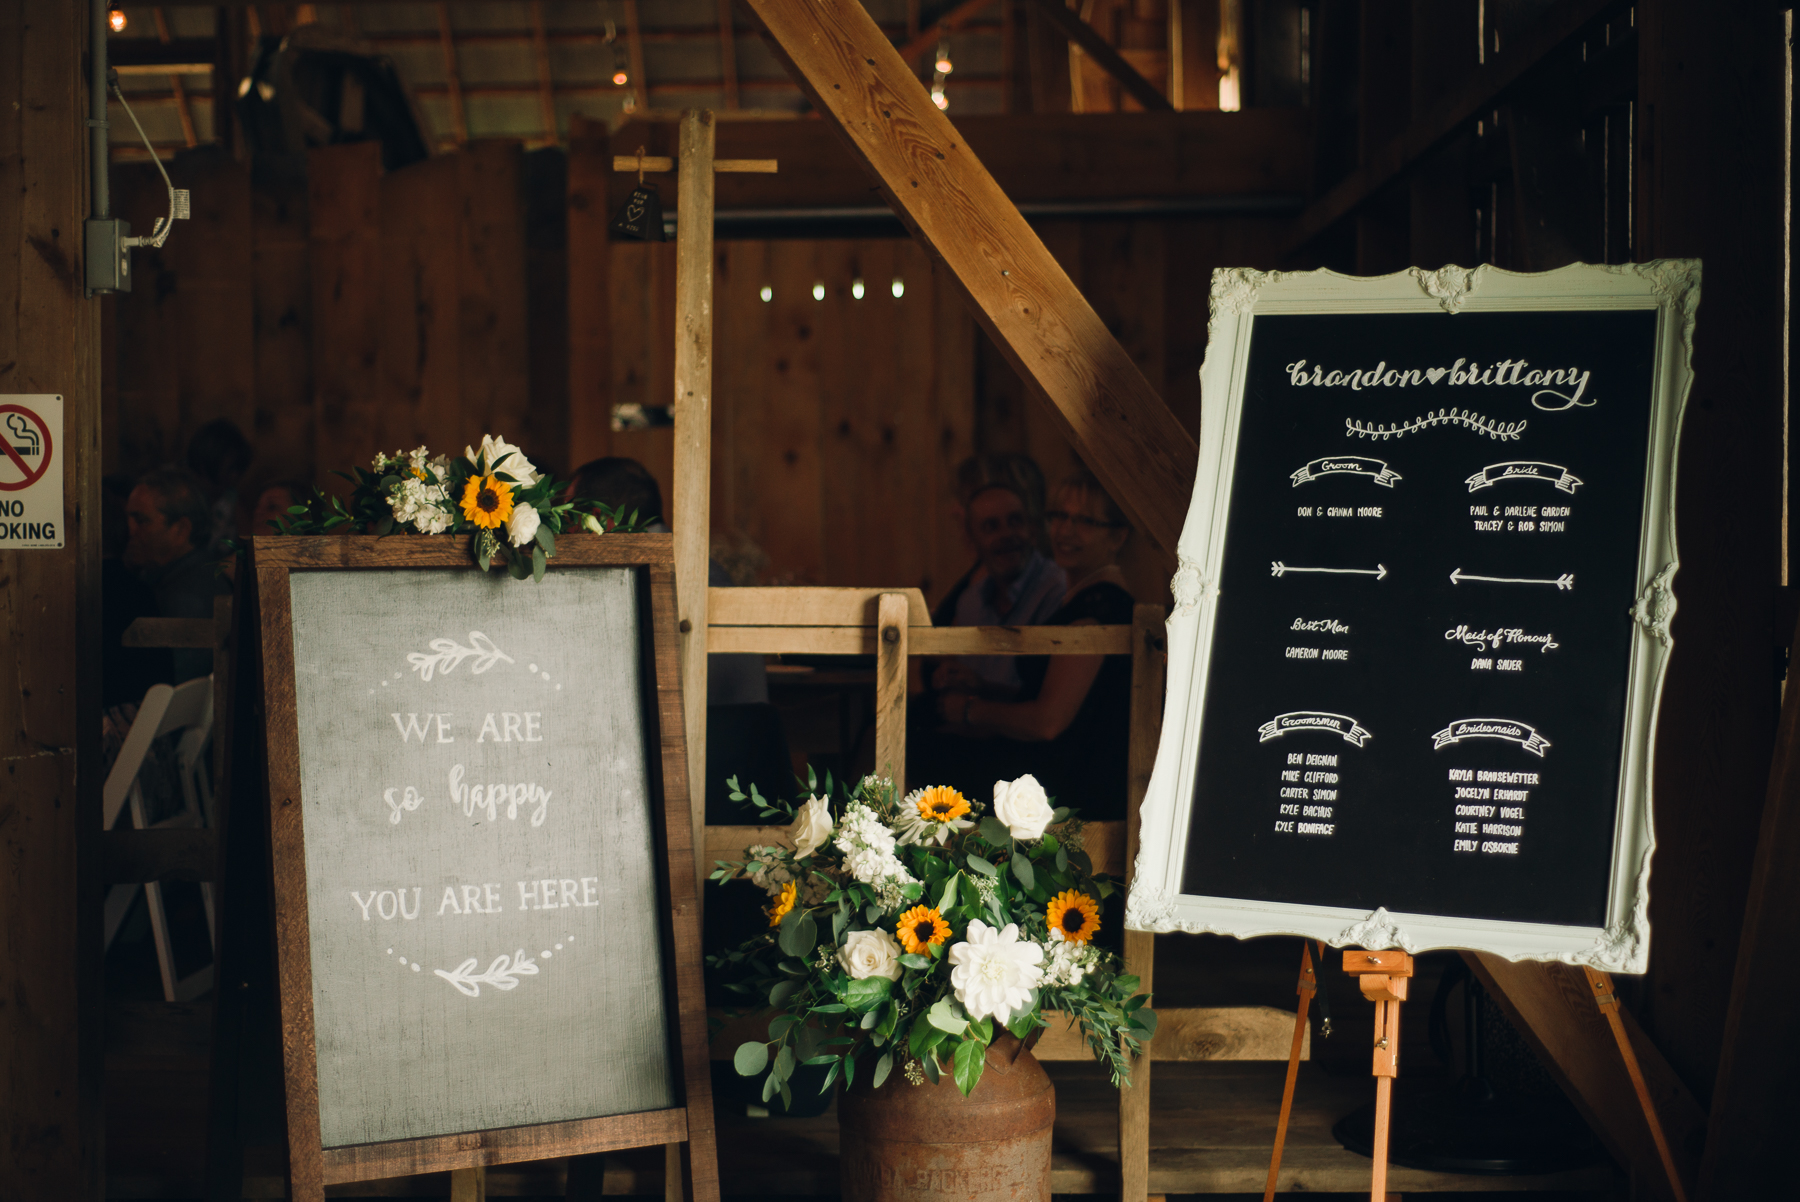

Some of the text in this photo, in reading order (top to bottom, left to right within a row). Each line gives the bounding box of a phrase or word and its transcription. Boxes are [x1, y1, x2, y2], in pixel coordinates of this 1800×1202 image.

[1286, 357, 1597, 410] brandon brittany
[1321, 461, 1362, 471] Groom
[1503, 465, 1539, 475] Bride
[1297, 506, 1382, 518] DON & GIANNA MOORE
[1470, 505, 1570, 518] PAUL & DARLENE GARDEN
[1474, 520, 1565, 532] TRACEY & ROB SIMON
[1290, 617, 1349, 634] Best Man
[1444, 624, 1559, 653] Maid of Honour
[1285, 646, 1349, 660] CAMERON MOORE
[1470, 658, 1522, 671] DANA SAUER
[391, 711, 543, 743] WE ARE
[1281, 717, 1341, 729] Groomsmen
[1455, 723, 1521, 736] Bridesmaids
[1287, 753, 1338, 767] BEN DEIGNAN
[1281, 770, 1339, 783] MIKE CLIFFORD
[1448, 768, 1539, 784] KAYLA BRAUSEWETTER
[383, 764, 552, 827] so happy
[1280, 787, 1338, 800] CARTER SIMON
[1455, 786, 1529, 801] JOCELYN ERHARDT
[1280, 803, 1333, 818] KYLE BACHUS
[1455, 804, 1525, 819] COURTNEY VOGEL
[1274, 820, 1335, 835] KYLE BONIFACE
[1455, 821, 1522, 836] KATIE HARRISON
[1454, 839, 1519, 854] EMILY OSBORNE
[352, 877, 599, 920] YOU ARE HERE
